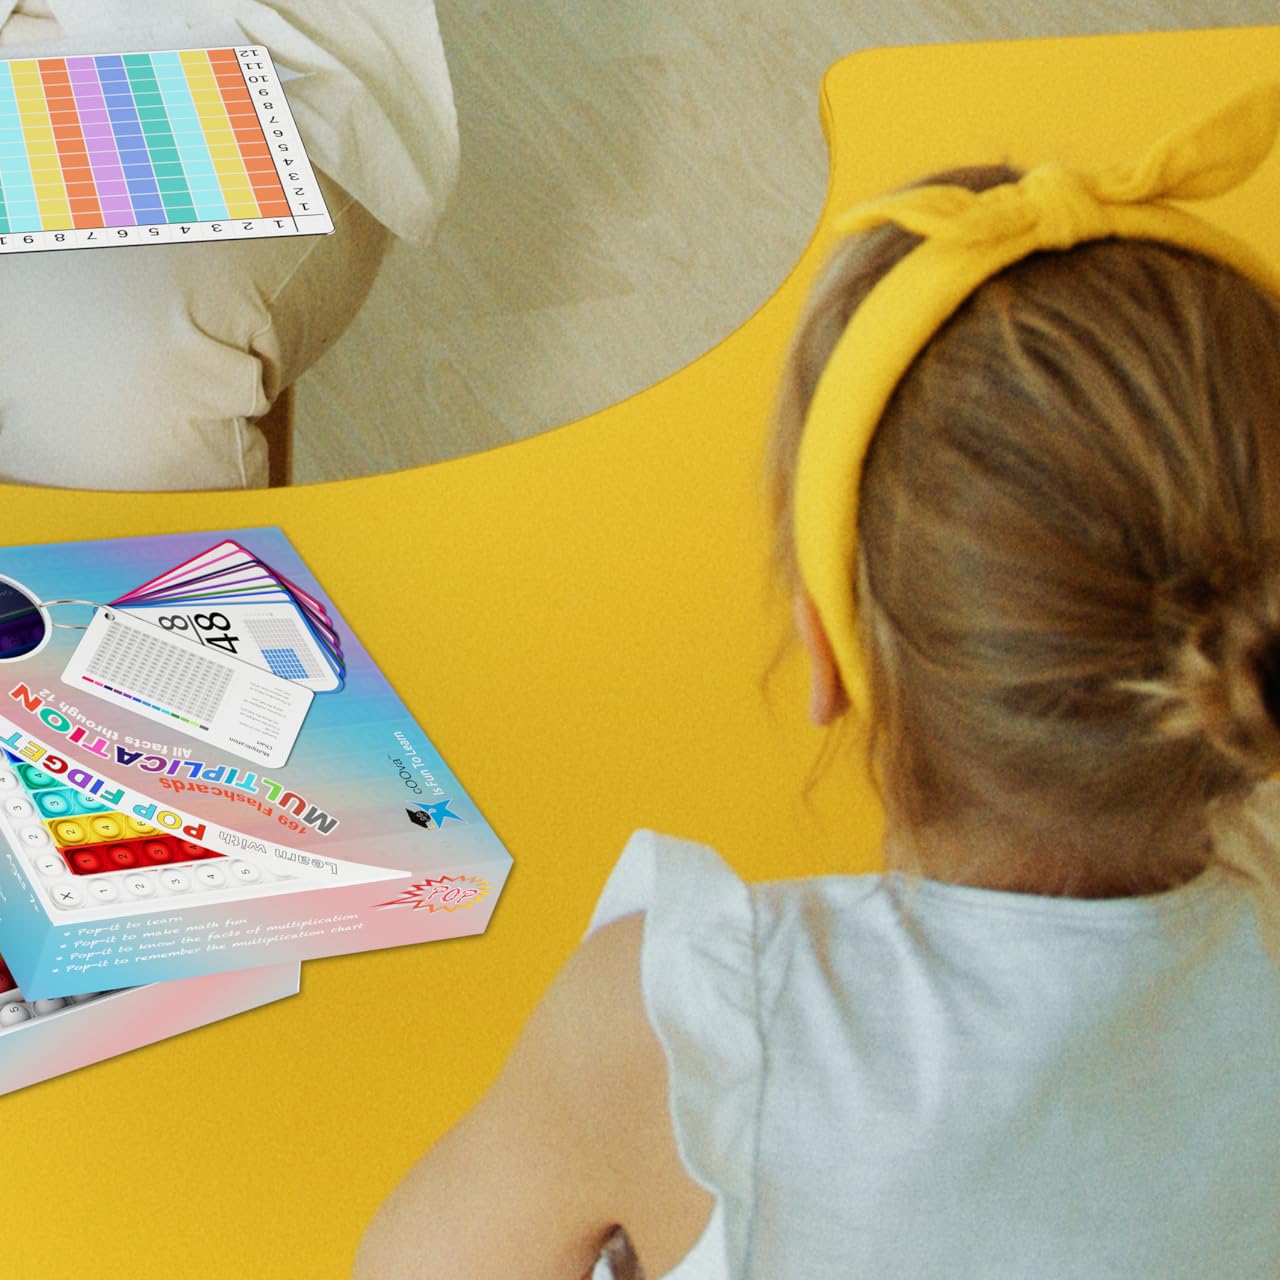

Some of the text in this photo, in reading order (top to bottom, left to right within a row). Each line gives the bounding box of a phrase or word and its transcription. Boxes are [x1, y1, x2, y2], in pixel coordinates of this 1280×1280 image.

[238, 49, 261, 58] 12
[243, 62, 265, 70] 11
[247, 75, 269, 83] 10
[258, 88, 269, 97] 9
[262, 101, 274, 110] 8
[268, 115, 279, 124] 7
[272, 129, 284, 137] 6
[277, 142, 289, 151] 5
[281, 157, 294, 166] 4
[288, 172, 299, 181] 3
[292, 187, 305, 196] 2
[298, 202, 311, 211] 1
[211, 223, 223, 233] 3
[241, 221, 254, 230] 2
[273, 220, 286, 228] 1
[117, 229, 129, 238] 6
[148, 227, 160, 236] 5
[179, 225, 192, 235] 4
[22, 234, 35, 244] 9
[54, 232, 66, 242] 8
[86, 231, 98, 240] 7
[158, 615, 189, 631] 8
[194, 612, 240, 654] 48
[39, 688, 192, 758] All facts through 12
[9, 682, 340, 835] MULTIPLICATION
[393, 730, 445, 796] Is Fun To Learn
[159, 777, 307, 835] 169 Flashcards
[132, 803, 207, 841] POP
[219, 830, 267, 854] with
[274, 848, 338, 875] Learn
[428, 885, 479, 903] POP
[126, 921, 141, 929] to
[143, 928, 179, 938] make
[186, 921, 219, 932] math
[225, 917, 248, 927] fun
[181, 936, 201, 944] the
[208, 930, 241, 941] facts
[246, 926, 261, 935] of
[266, 913, 359, 930] multiplication
[135, 947, 201, 963] remember
[206, 944, 226, 952] the
[232, 929, 325, 946] multiplication
[330, 923, 364, 934] chart
